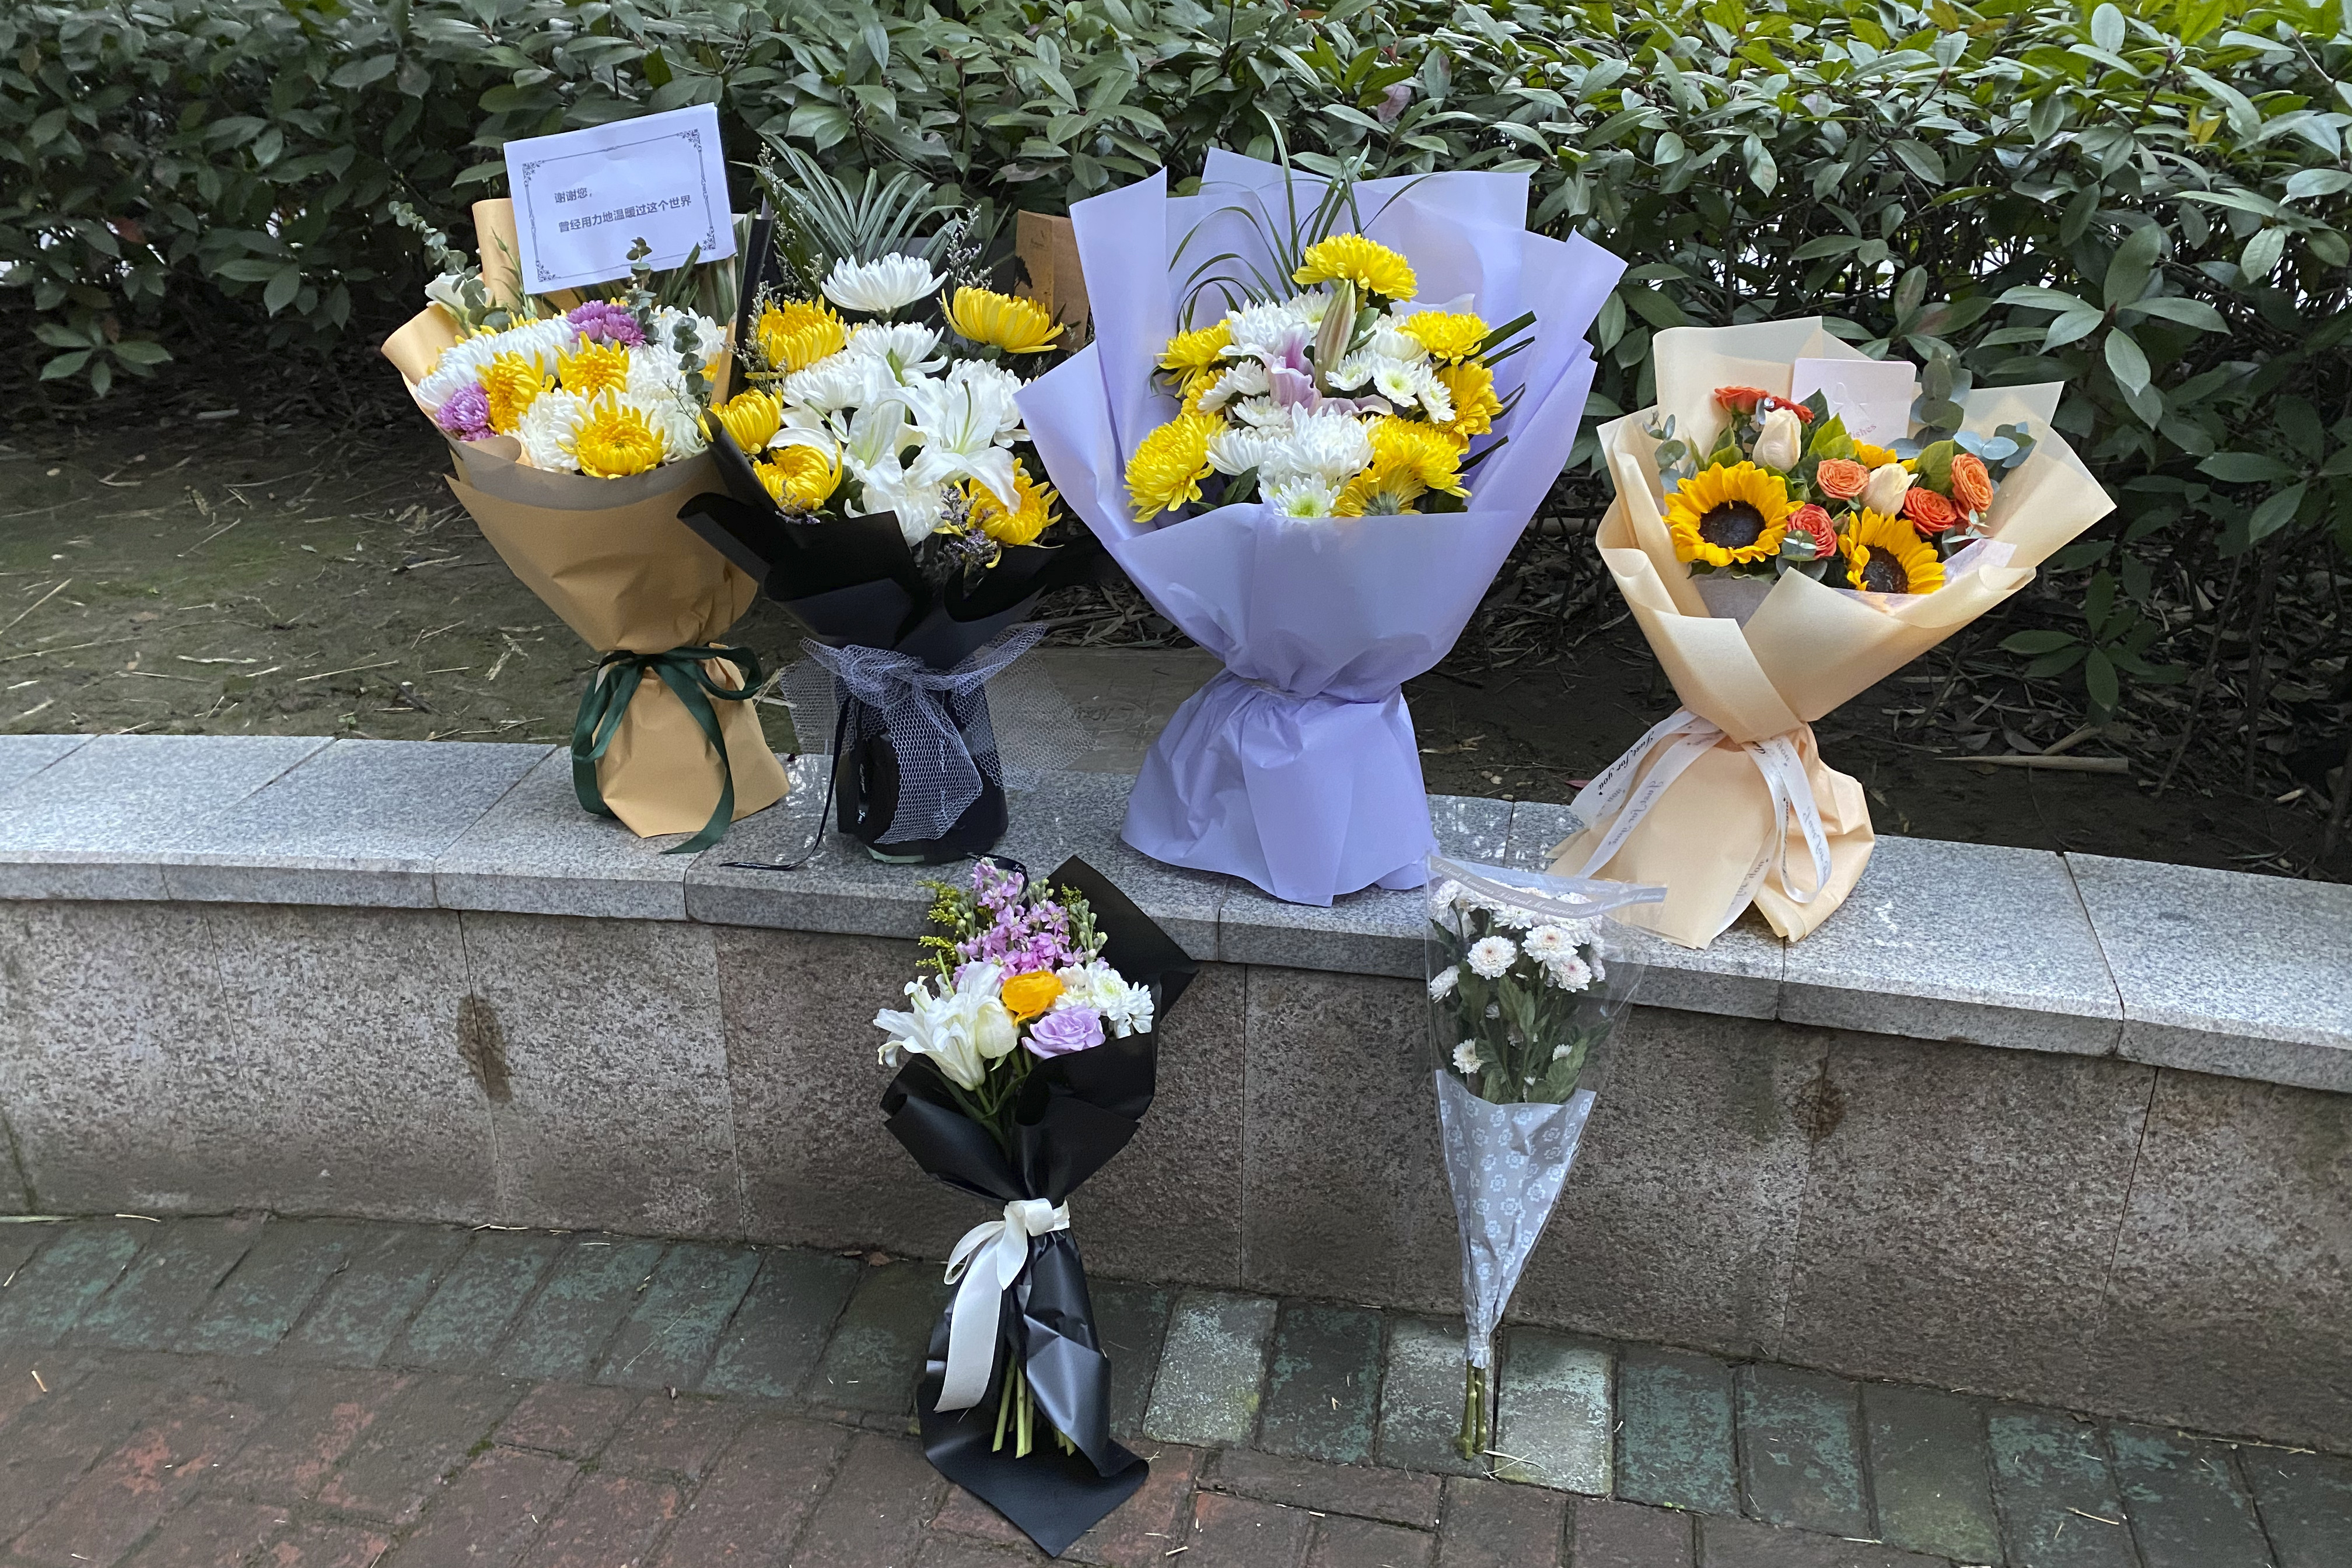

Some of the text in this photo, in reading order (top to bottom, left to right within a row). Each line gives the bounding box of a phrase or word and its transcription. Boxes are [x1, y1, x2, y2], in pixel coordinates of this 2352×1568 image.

[558, 195, 691, 233] 曾经用力地温暖过这个世界
[1852, 424, 1877, 439] ishes
[1598, 730, 1654, 791] Just for you
